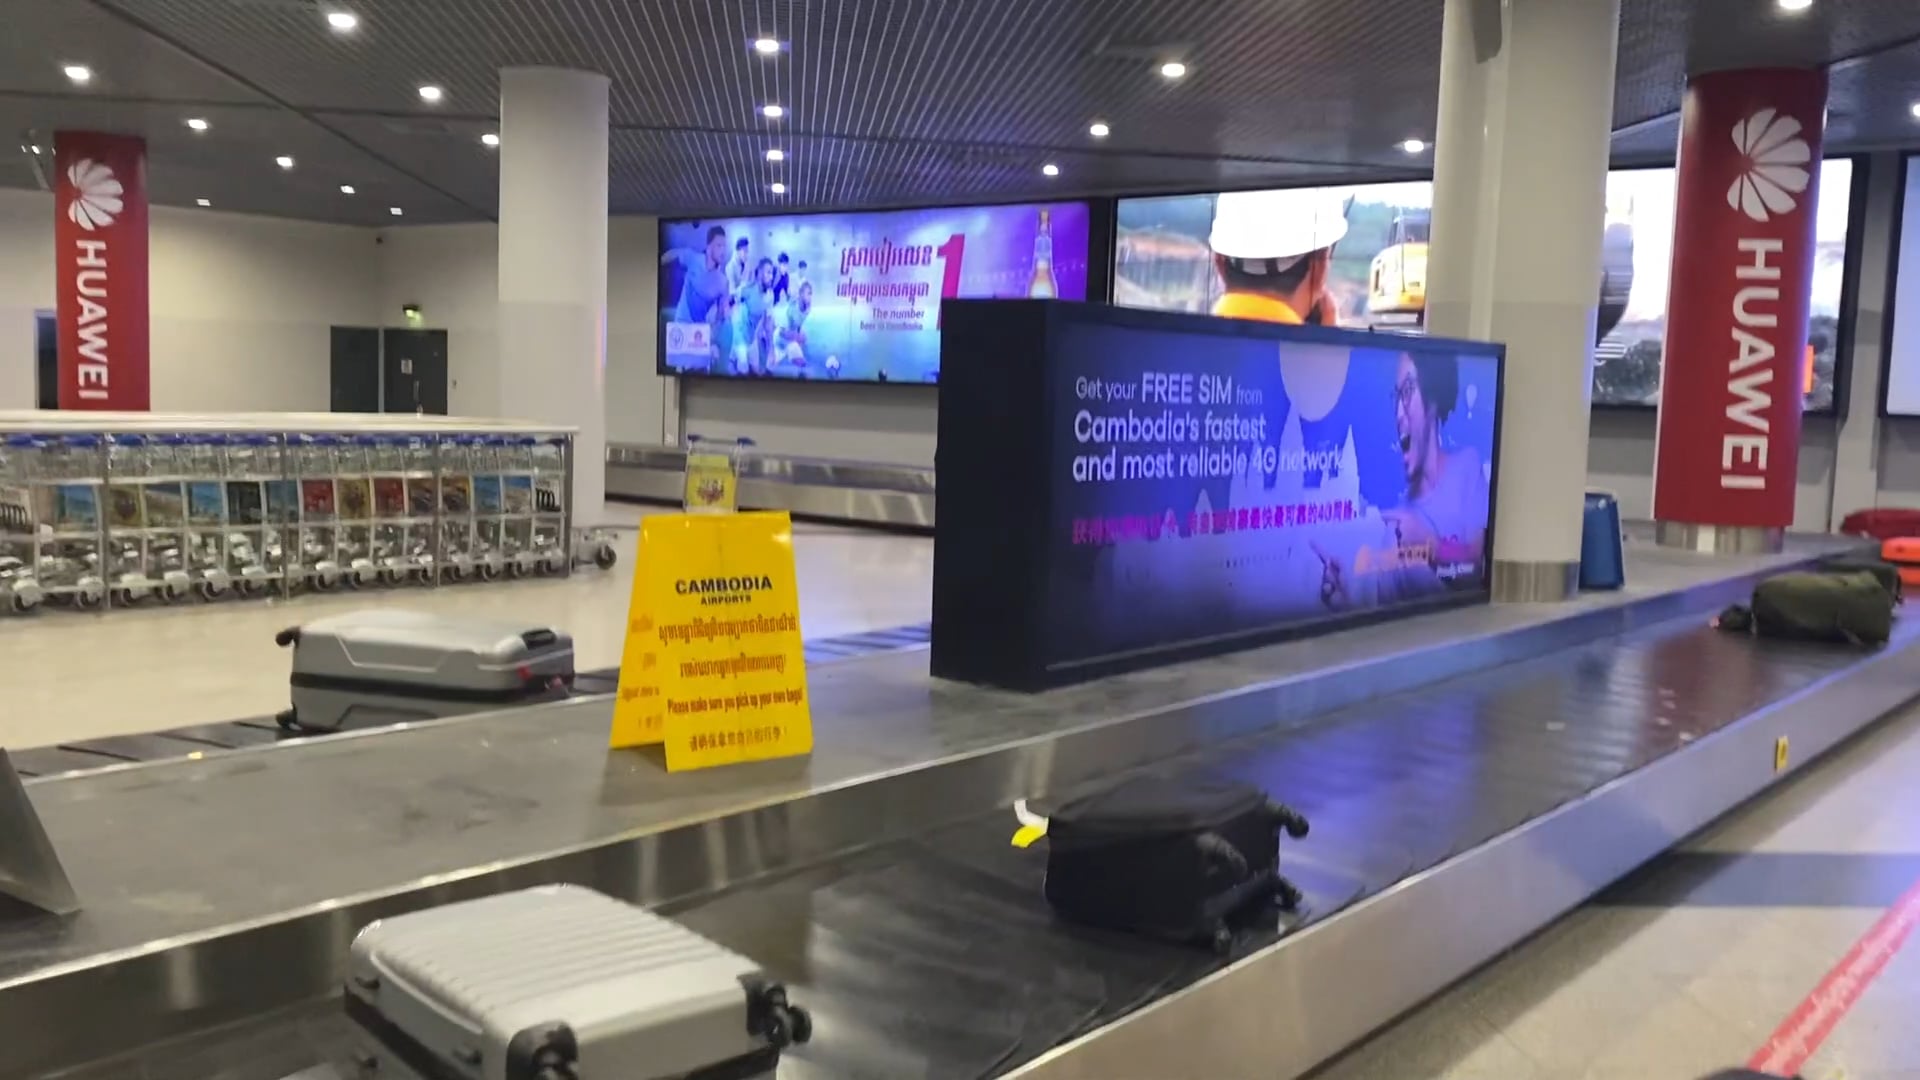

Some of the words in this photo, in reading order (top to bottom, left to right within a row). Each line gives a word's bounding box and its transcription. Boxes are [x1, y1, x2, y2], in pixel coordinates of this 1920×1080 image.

[76, 240, 109, 399] HUAWEI
[872, 307, 888, 319] The
[890, 307, 925, 319] number
[1721, 238, 1783, 489] HUAWEI
[1075, 376, 1102, 399] Get
[1105, 381, 1137, 403] your
[1142, 371, 1194, 404] FREE
[1198, 373, 1232, 405] SIM
[1236, 385, 1263, 405] from
[1074, 408, 1200, 443] Cambodia's
[1204, 410, 1267, 442] fastest
[1072, 446, 1116, 482] and
[1122, 447, 1175, 479] most
[1180, 445, 1248, 478] reliable
[1252, 445, 1277, 473] 4G
[1280, 442, 1343, 472] network
[675, 576, 773, 595] CAMBODIA
[700, 594, 752, 606] AIRPORTS
[667, 696, 689, 713] Please
[690, 695, 708, 711] make
[709, 697, 723, 710] sure
[724, 697, 736, 712] you
[736, 690, 749, 712] pick
[749, 694, 759, 709] up
[759, 693, 772, 710] your
[773, 691, 786, 704] own
